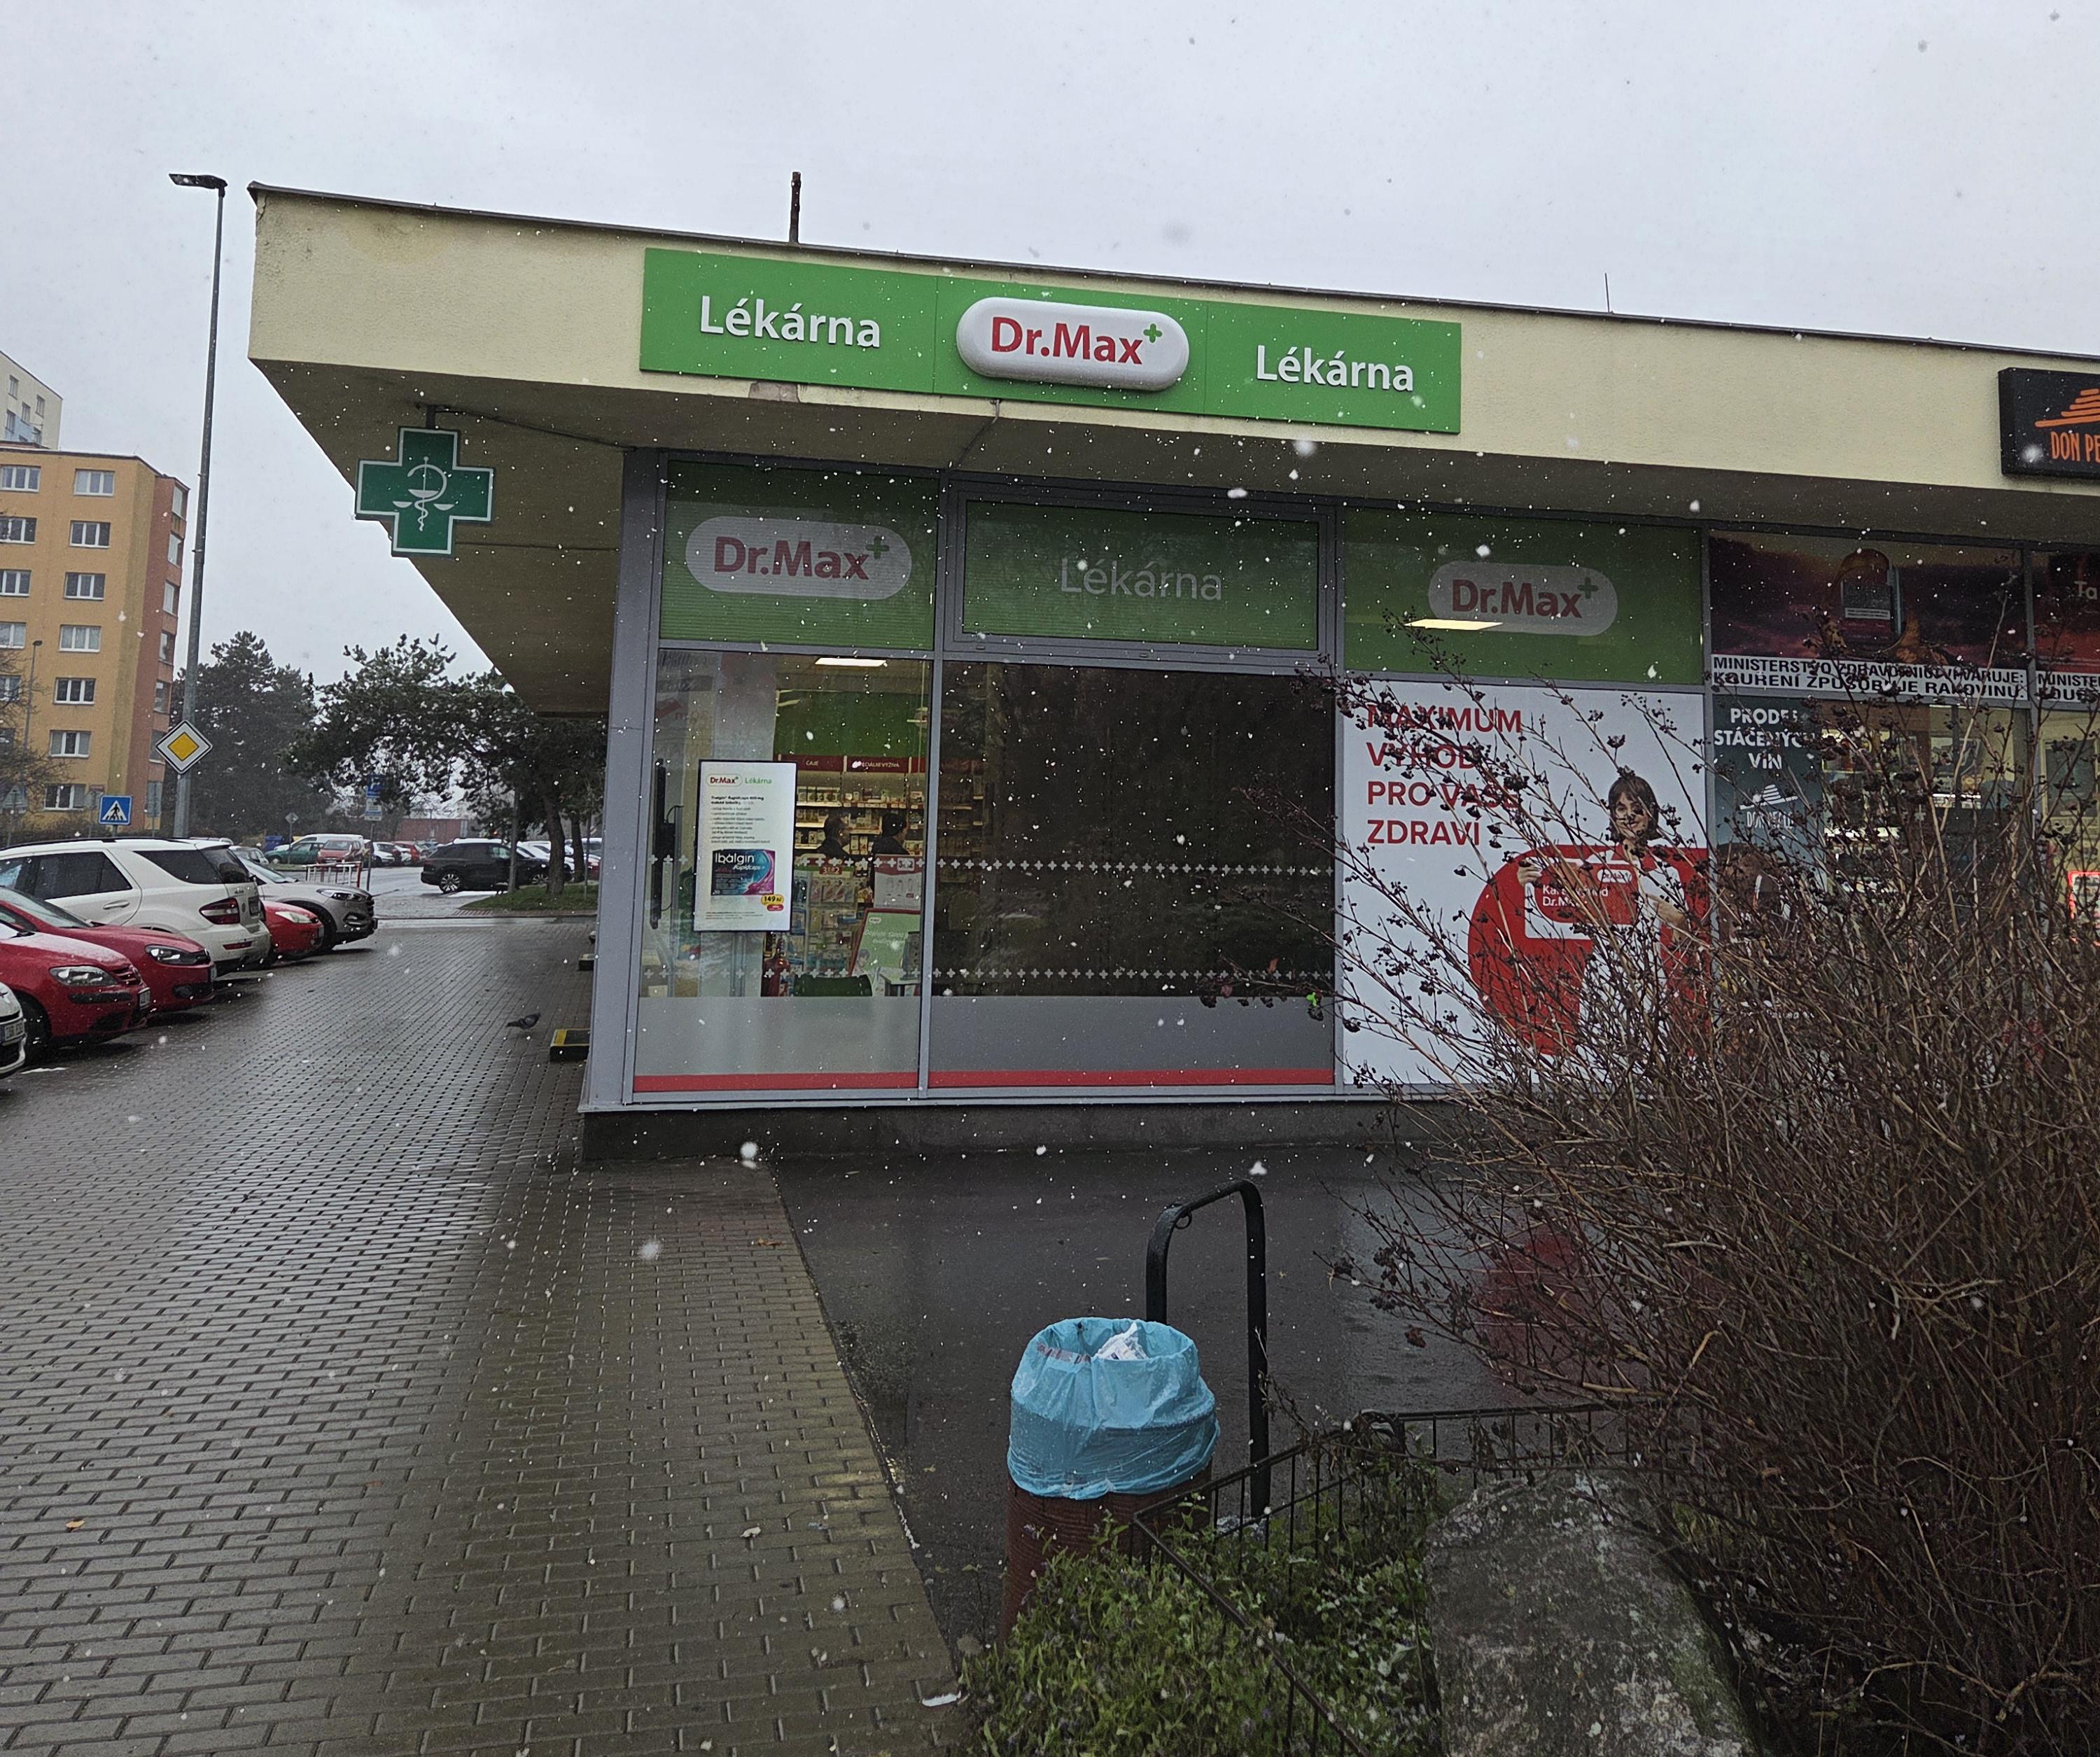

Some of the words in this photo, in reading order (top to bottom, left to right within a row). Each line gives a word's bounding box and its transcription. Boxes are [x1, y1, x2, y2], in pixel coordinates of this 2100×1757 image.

[700, 295, 881, 348] Lékárna
[990, 316, 1143, 365] Dr.Max
[1256, 344, 1414, 392] Lékárna
[2050, 431, 2081, 462] DON
[714, 536, 869, 580] Dr.Max
[1060, 558, 1222, 601] Lékárna
[1452, 579, 1582, 619] Dr.Max
[1366, 704, 1522, 734] MAXIMUM
[1714, 727, 1816, 748] STÁČEÝC
[744, 776, 773, 785] Lékárna
[1367, 780, 1432, 807] PRO
[715, 852, 755, 865] Ibalgin
